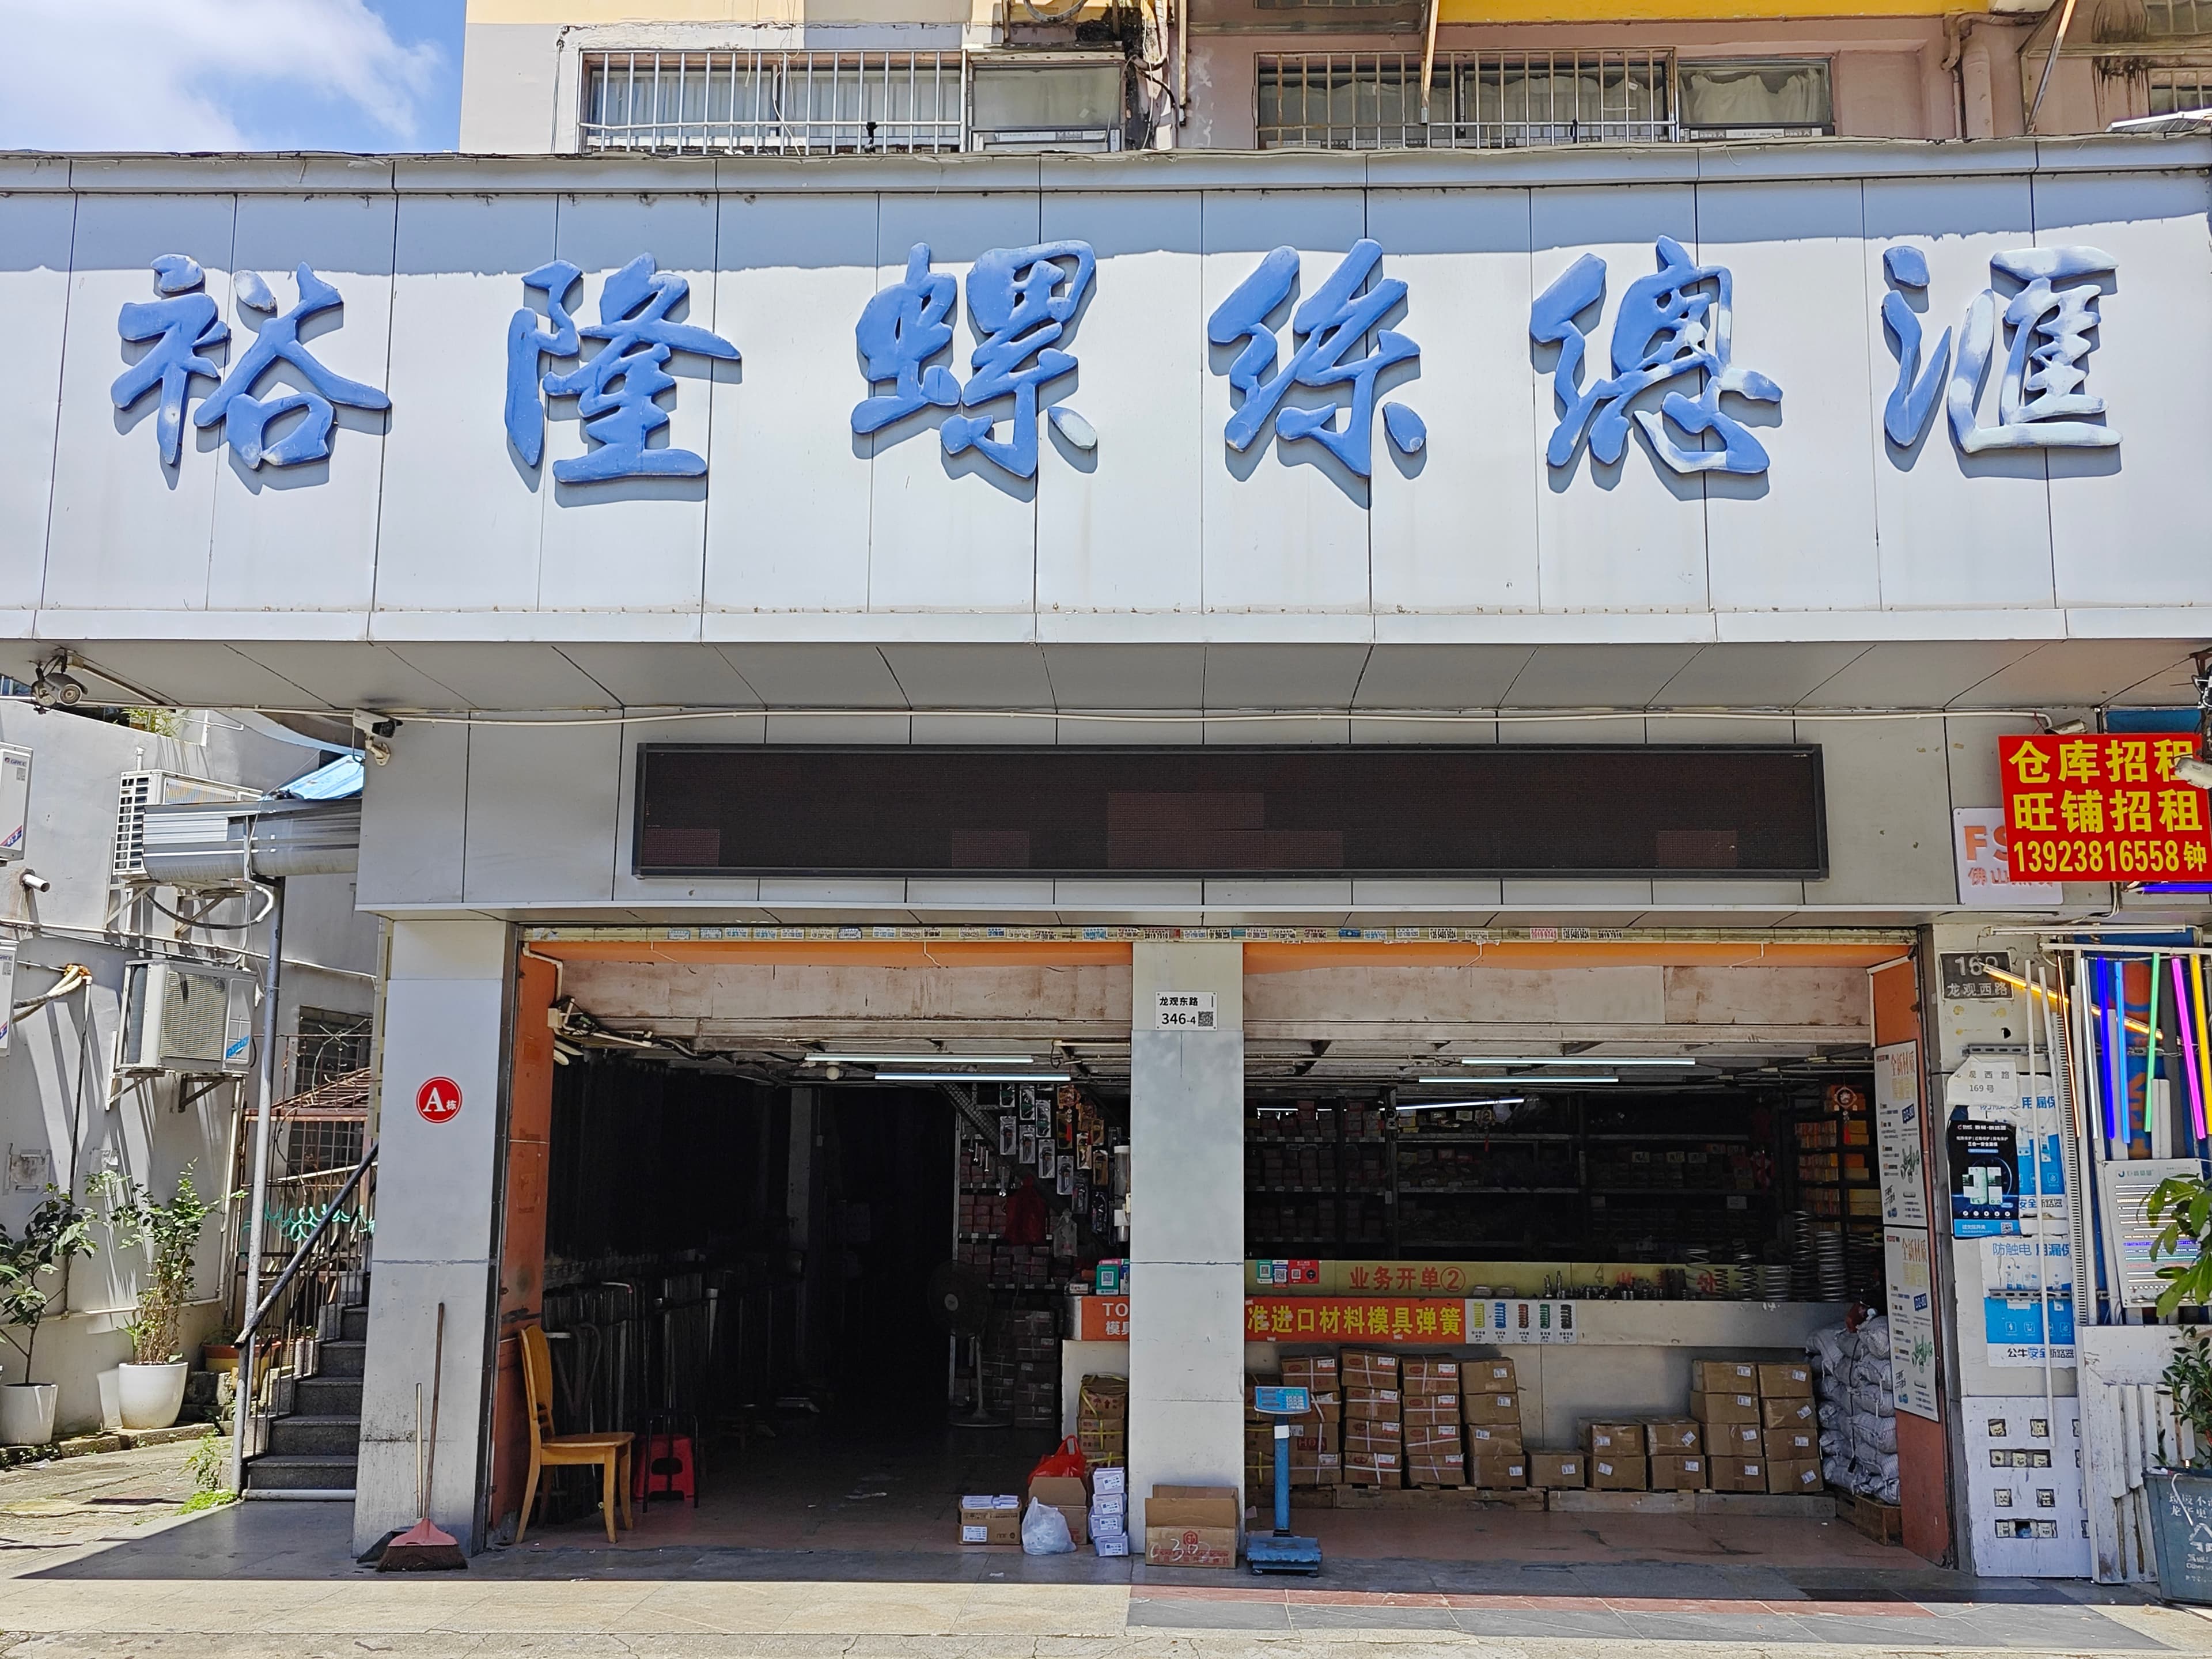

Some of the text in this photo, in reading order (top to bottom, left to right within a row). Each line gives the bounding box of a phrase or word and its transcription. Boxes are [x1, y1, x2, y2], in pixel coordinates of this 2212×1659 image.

[2009, 739, 2194, 784] 仓库招租
[2013, 789, 2202, 833] 旺铺招租
[2014, 840, 2207, 872] 13923816558 钟
[1160, 997, 1198, 1006] 龙观东路
[1947, 982, 2008, 997] 龙观西路
[1162, 1013, 1196, 1025] 346-4
[1891, 1050, 1915, 1077] 全新材质
[1902, 1238, 1927, 1263] 全新材质
[1993, 1243, 2032, 1256] 防触电
[1247, 1305, 1461, 1336] 准进口材料模具弹簧
